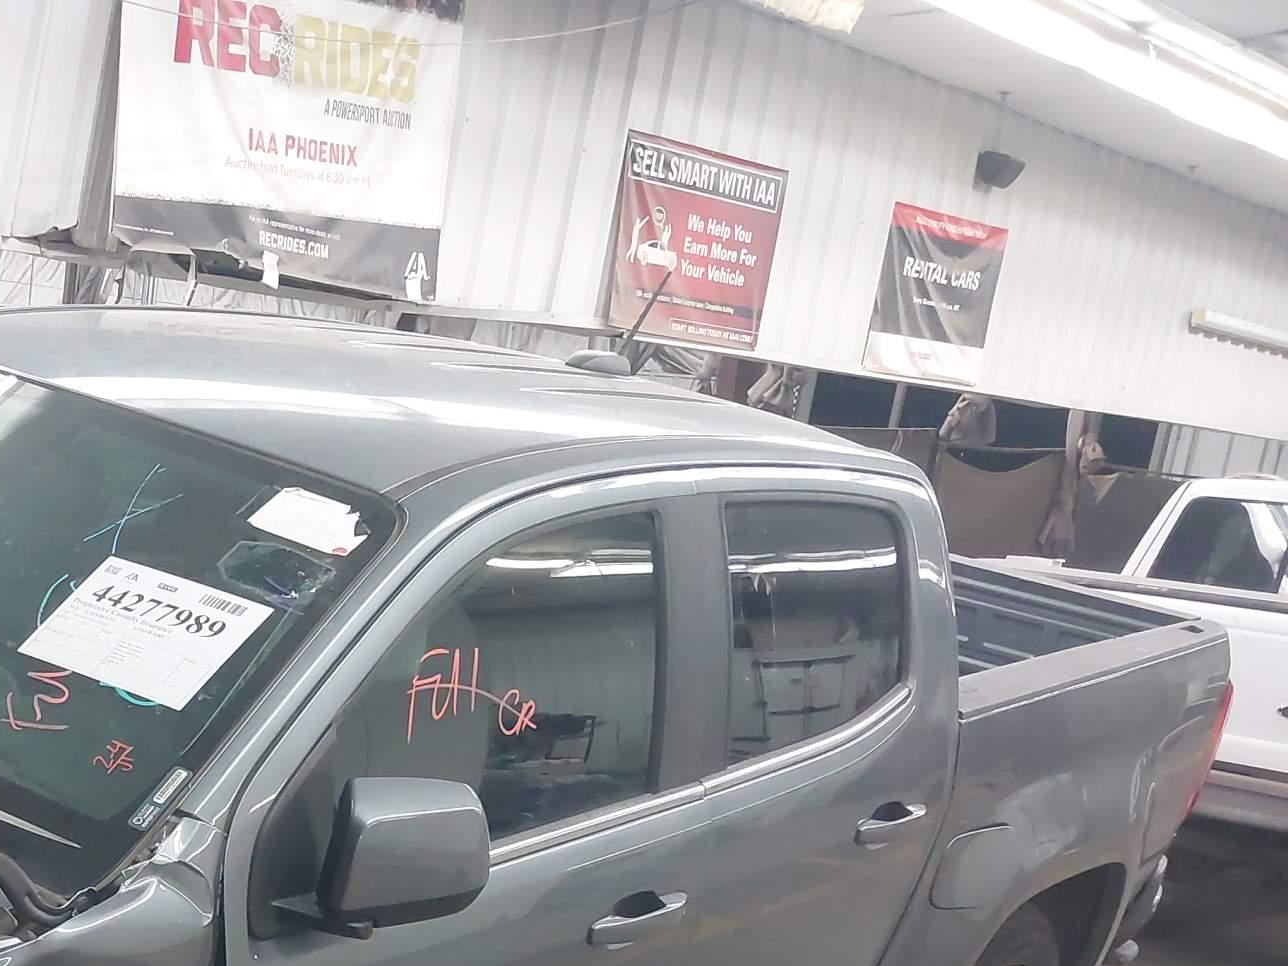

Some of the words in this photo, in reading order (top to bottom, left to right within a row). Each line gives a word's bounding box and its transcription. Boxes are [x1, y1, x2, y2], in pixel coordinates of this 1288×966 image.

[174, 0, 281, 77] REC
[292, 13, 421, 103] RIDES
[323, 98, 330, 116] A
[331, 100, 380, 125] POWERSPORT
[248, 127, 278, 156] IAA
[285, 134, 358, 168] PHOENIX
[633, 147, 665, 179] SELL
[668, 156, 718, 191] SMART
[718, 168, 752, 200] WITH
[752, 178, 776, 207] IAA
[258, 230, 329, 259] RECRIDES.COM
[687, 213, 705, 233] We
[707, 218, 731, 241] Help
[733, 224, 753, 244] You
[683, 236, 708, 257] Earn
[710, 242, 738, 263] More
[739, 248, 757, 267] For
[680, 259, 705, 279] Your
[707, 263, 745, 287] Vehicle
[903, 255, 948, 285] RENTAL
[951, 270, 981, 291] CARS
[92, 584, 227, 638] 44277989
